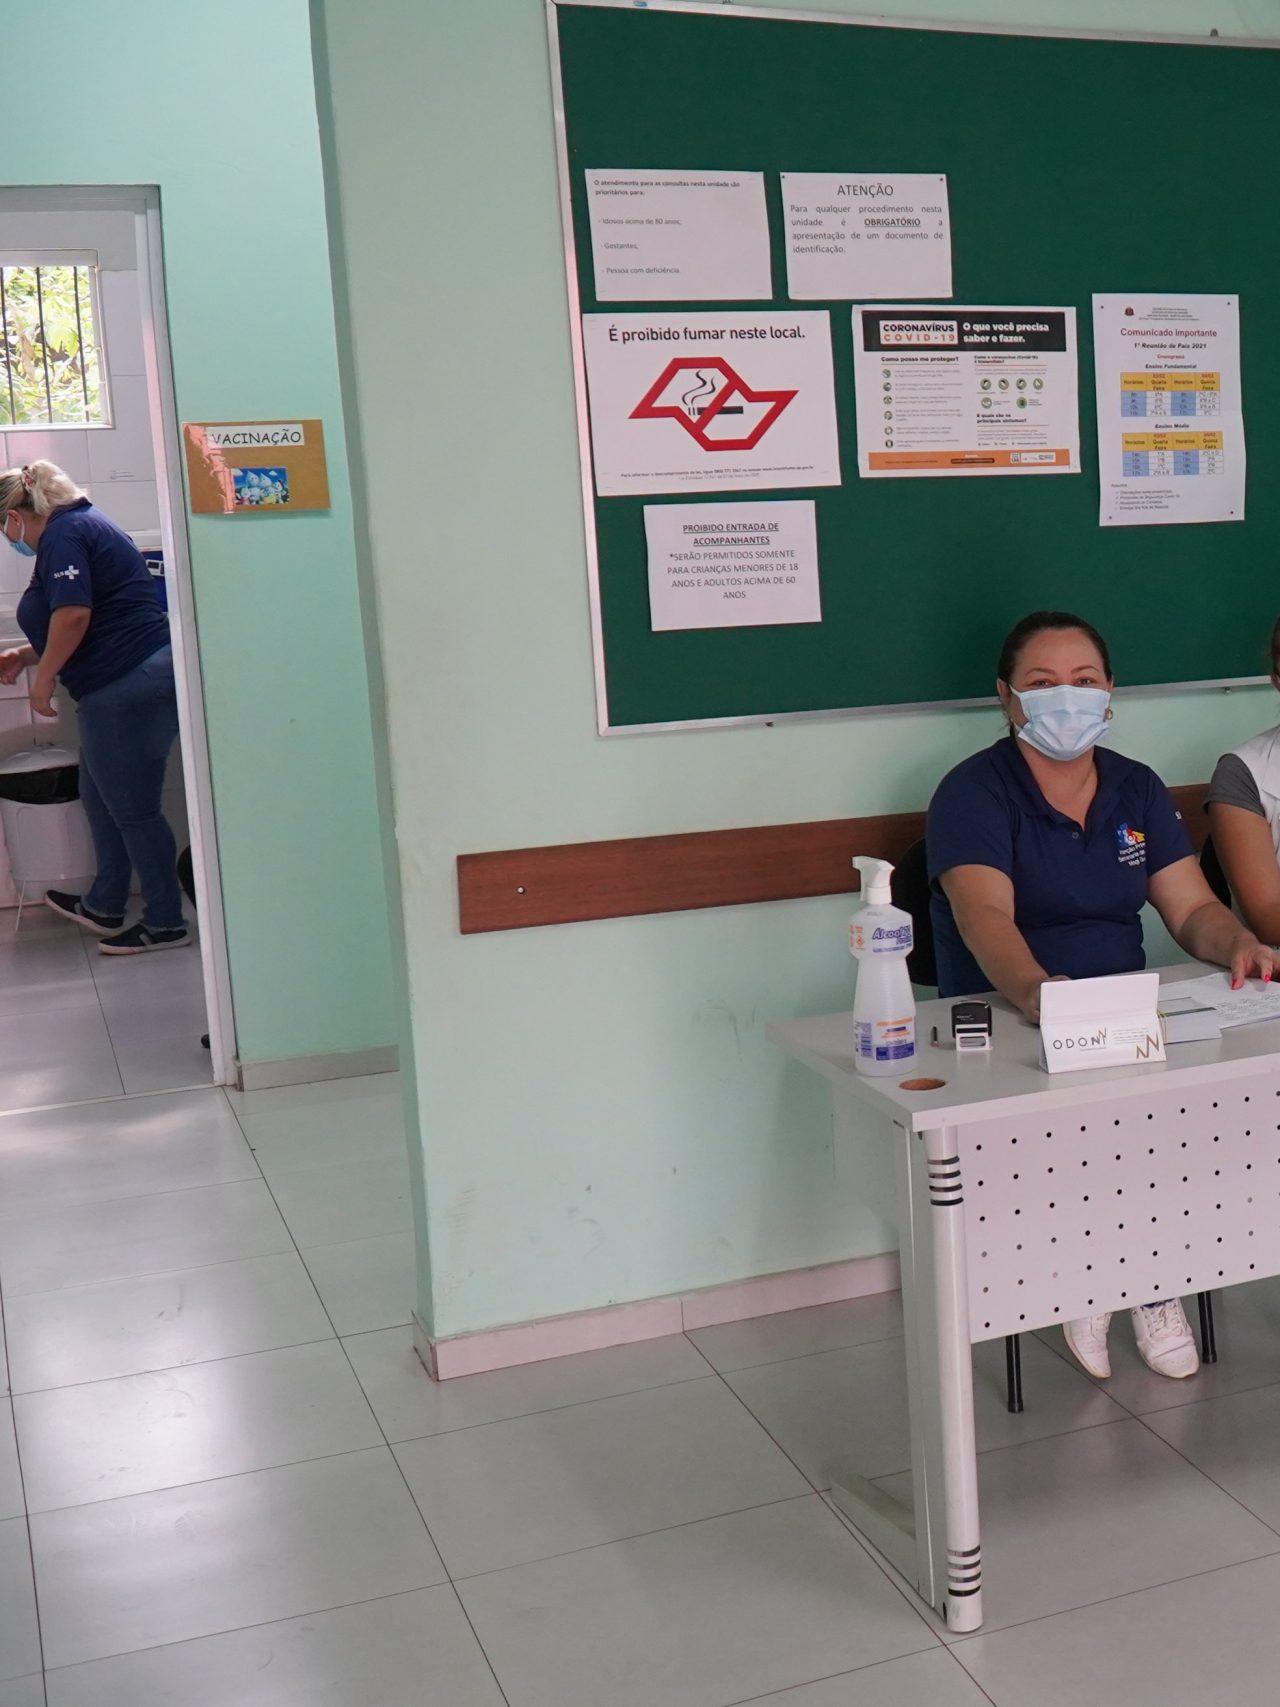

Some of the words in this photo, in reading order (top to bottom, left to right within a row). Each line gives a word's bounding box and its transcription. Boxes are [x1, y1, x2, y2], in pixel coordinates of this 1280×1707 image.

[837, 183, 894, 198] ATENÇÃO
[791, 205, 808, 213] Para
[816, 205, 851, 215] qualquer
[859, 205, 914, 215] procedimento
[792, 218, 823, 226] unidade
[864, 217, 921, 226] OBRIGATÓRIO
[792, 232, 845, 242] apresentação
[885, 232, 928, 240] documento
[934, 232, 944, 240] de
[793, 245, 846, 254] identificação.
[883, 322, 955, 332] CORONAVÍRUS
[963, 323, 971, 331] O
[973, 323, 991, 333] que
[992, 322, 1015, 332] você
[1016, 323, 1049, 334] precisa
[1121, 328, 1173, 337] Comunicado
[1176, 329, 1218, 338] Importante
[609, 324, 619, 342] É
[622, 326, 680, 344] proibido
[683, 326, 726, 341] fumar
[730, 327, 767, 339] neste
[770, 326, 806, 339] local.
[963, 334, 990, 343] saber
[999, 334, 1026, 343] fazer.
[212, 429, 302, 445] VACINAÇÃO
[683, 524, 724, 533] PROIBIDO
[726, 523, 766, 531] ENTRADA
[768, 522, 780, 531] DE
[693, 536, 771, 546] ACOMPANHANTES
[703, 551, 754, 560] PERMITIDOS
[756, 550, 795, 559] SOMENTE
[667, 567, 690, 575] PARA
[691, 565, 732, 575] CRIANÇAS
[734, 564, 774, 573] MENORES
[789, 563, 799, 571] 18
[672, 580, 695, 588] ANOS
[697, 579, 702, 587] E
[704, 578, 742, 587] ADULTOS
[743, 577, 771, 586] ACIMA
[773, 577, 784, 585] DE
[786, 576, 796, 584] 60
[723, 591, 746, 599] ANOS
